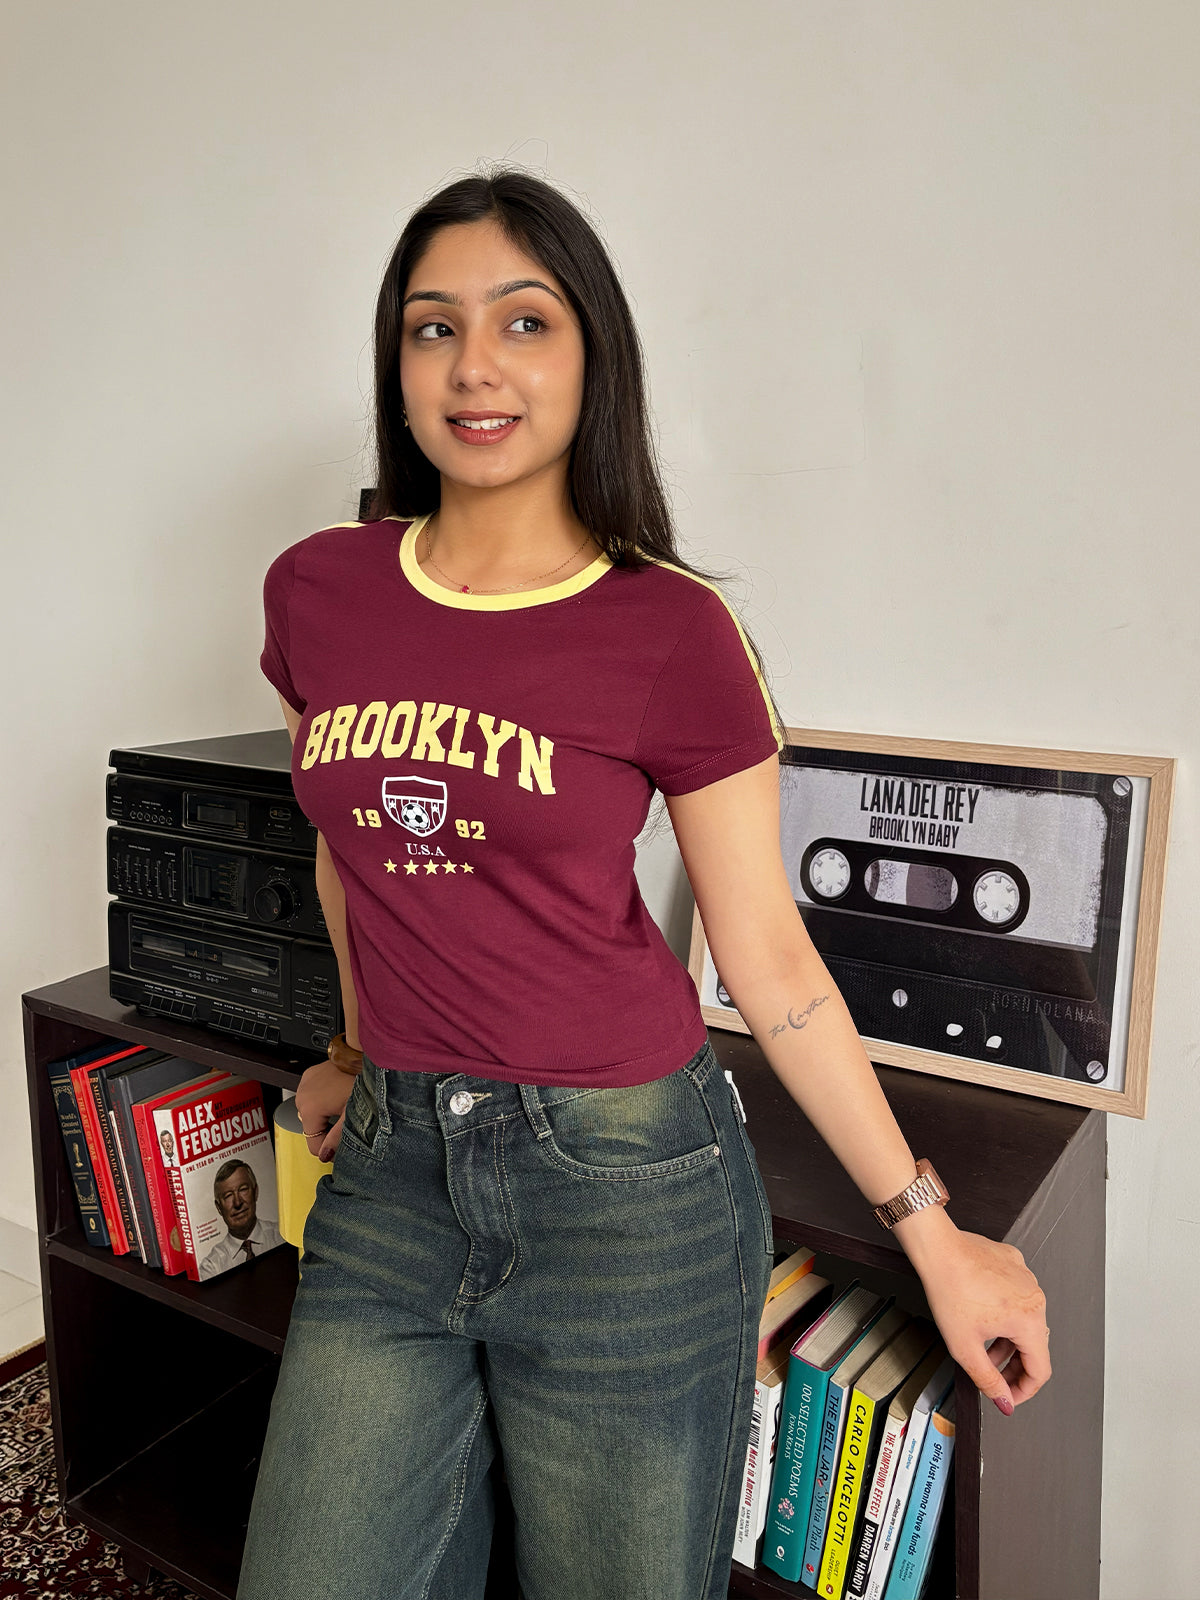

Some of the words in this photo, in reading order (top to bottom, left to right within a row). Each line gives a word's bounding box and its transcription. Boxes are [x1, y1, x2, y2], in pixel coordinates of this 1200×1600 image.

[301, 701, 556, 795] BROOKLYN
[860, 778, 905, 815] LANA
[908, 782, 939, 819] DEL
[943, 786, 980, 823] REY
[352, 808, 382, 828] 19
[455, 819, 486, 840] 92
[869, 816, 926, 844] BROOKLYN
[928, 823, 960, 848] BABY
[178, 1101, 216, 1134] ALEX
[181, 1107, 265, 1160] FERGUSON
[93, 1084, 112, 1145] MEDITATIONS
[108, 1149, 121, 1185] MARCUS
[118, 1188, 131, 1229] AURELIUS
[196, 1160, 207, 1170] YEAR
[171, 1169, 183, 1197] ALEX
[176, 1199, 195, 1254] FERGUSON
[801, 1384, 812, 1402] 100
[827, 1395, 839, 1418] THE
[793, 1403, 810, 1459] SELECTED
[823, 1421, 836, 1451] BELL
[849, 1405, 866, 1456] CARLO
[885, 1432, 896, 1447] THE
[748, 1448, 758, 1468] Made
[818, 1455, 831, 1481] JAR
[877, 1447, 892, 1488] COMPOUND
[932, 1443, 944, 1463] girls
[748, 1469, 756, 1477] in
[788, 1459, 802, 1497] POEMS
[927, 1462, 939, 1480] just
[744, 1478, 755, 1506] America
[833, 1460, 857, 1545] ANCELOTTI
[870, 1488, 883, 1518] EFFECT
[921, 1481, 933, 1509] wanna
[812, 1492, 827, 1523] Sylvia
[915, 1510, 927, 1532] have
[809, 1525, 822, 1551] Plath
[859, 1524, 875, 1560] DARREN
[908, 1533, 921, 1556] funds
[852, 1561, 867, 1592] HARDY
